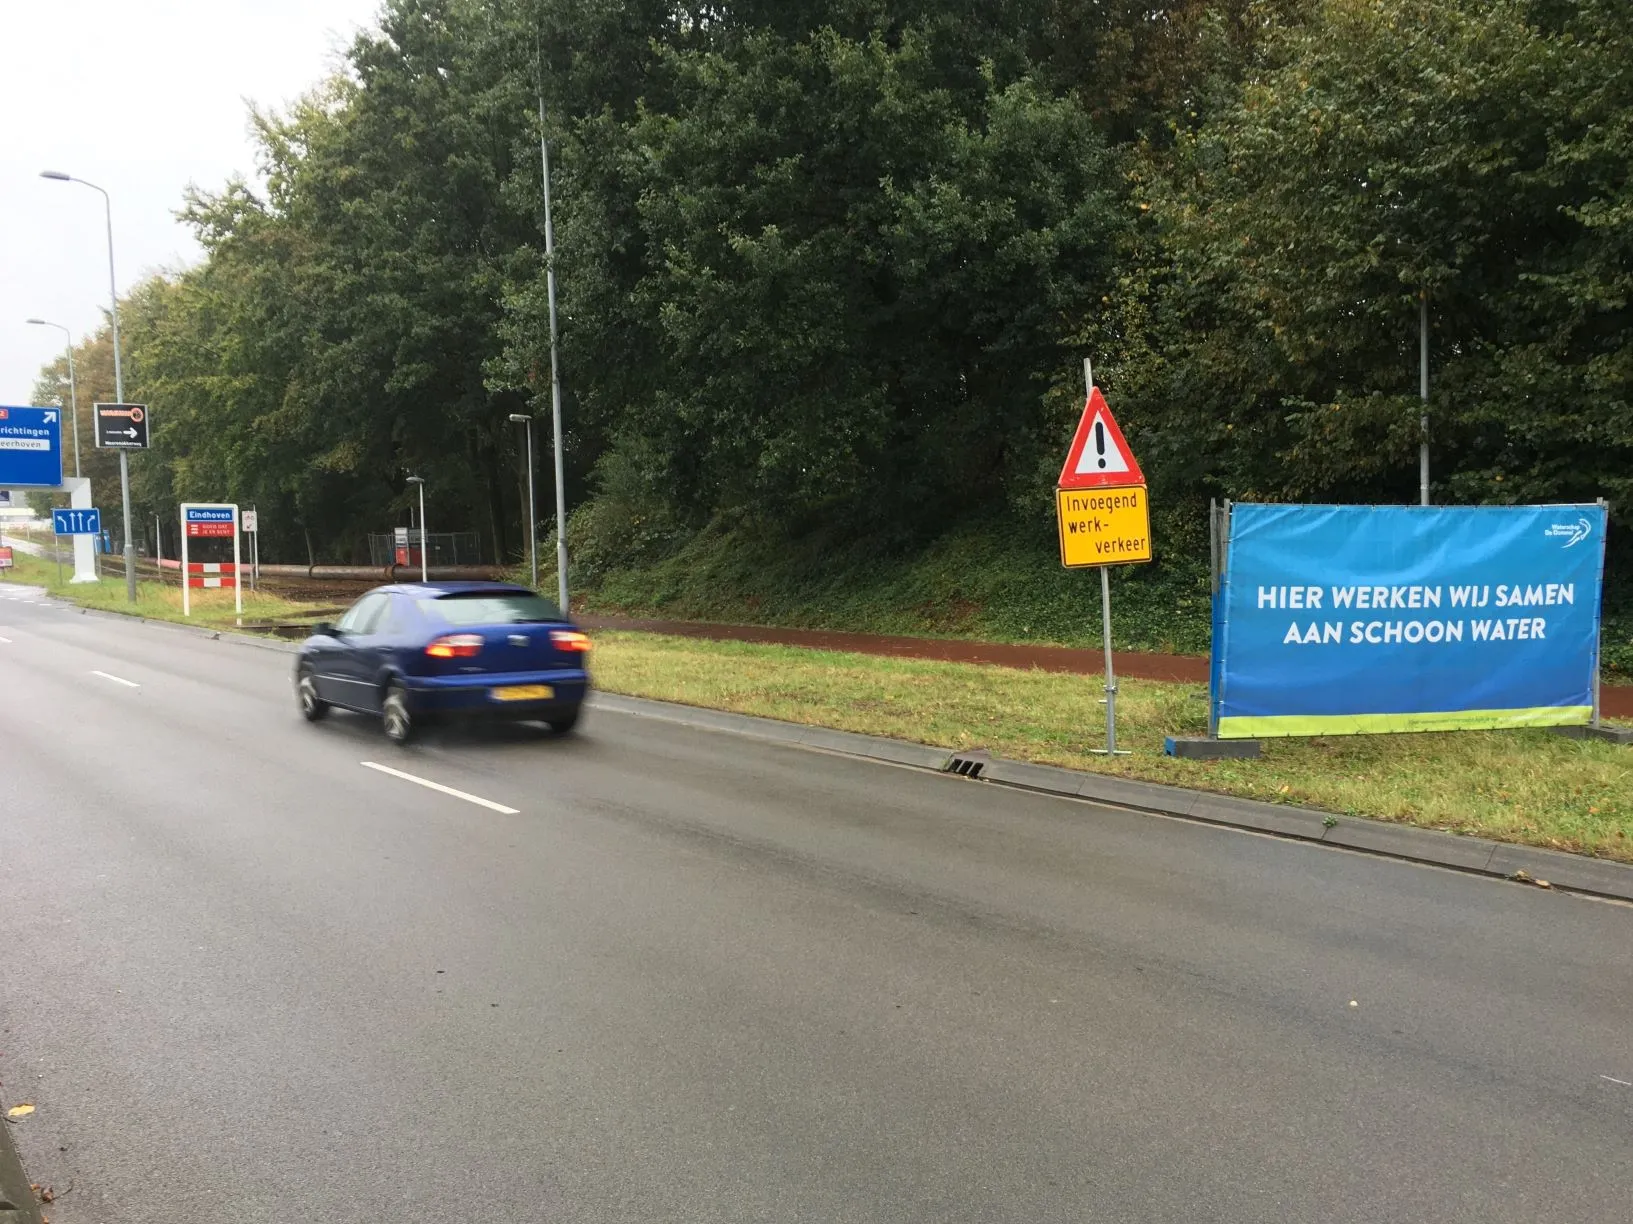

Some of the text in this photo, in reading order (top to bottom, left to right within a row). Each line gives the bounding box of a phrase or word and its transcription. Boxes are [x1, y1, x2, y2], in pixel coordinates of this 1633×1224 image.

[0, 426, 49, 436] richtingen
[1066, 492, 1137, 514] Invoegend
[1068, 517, 1109, 534] werk-
[1095, 537, 1146, 554] verkeer
[1257, 582, 1575, 609] HIER WERKEN WIJ SAMEN
[1283, 617, 1546, 644] AAN SCHOON WATER
